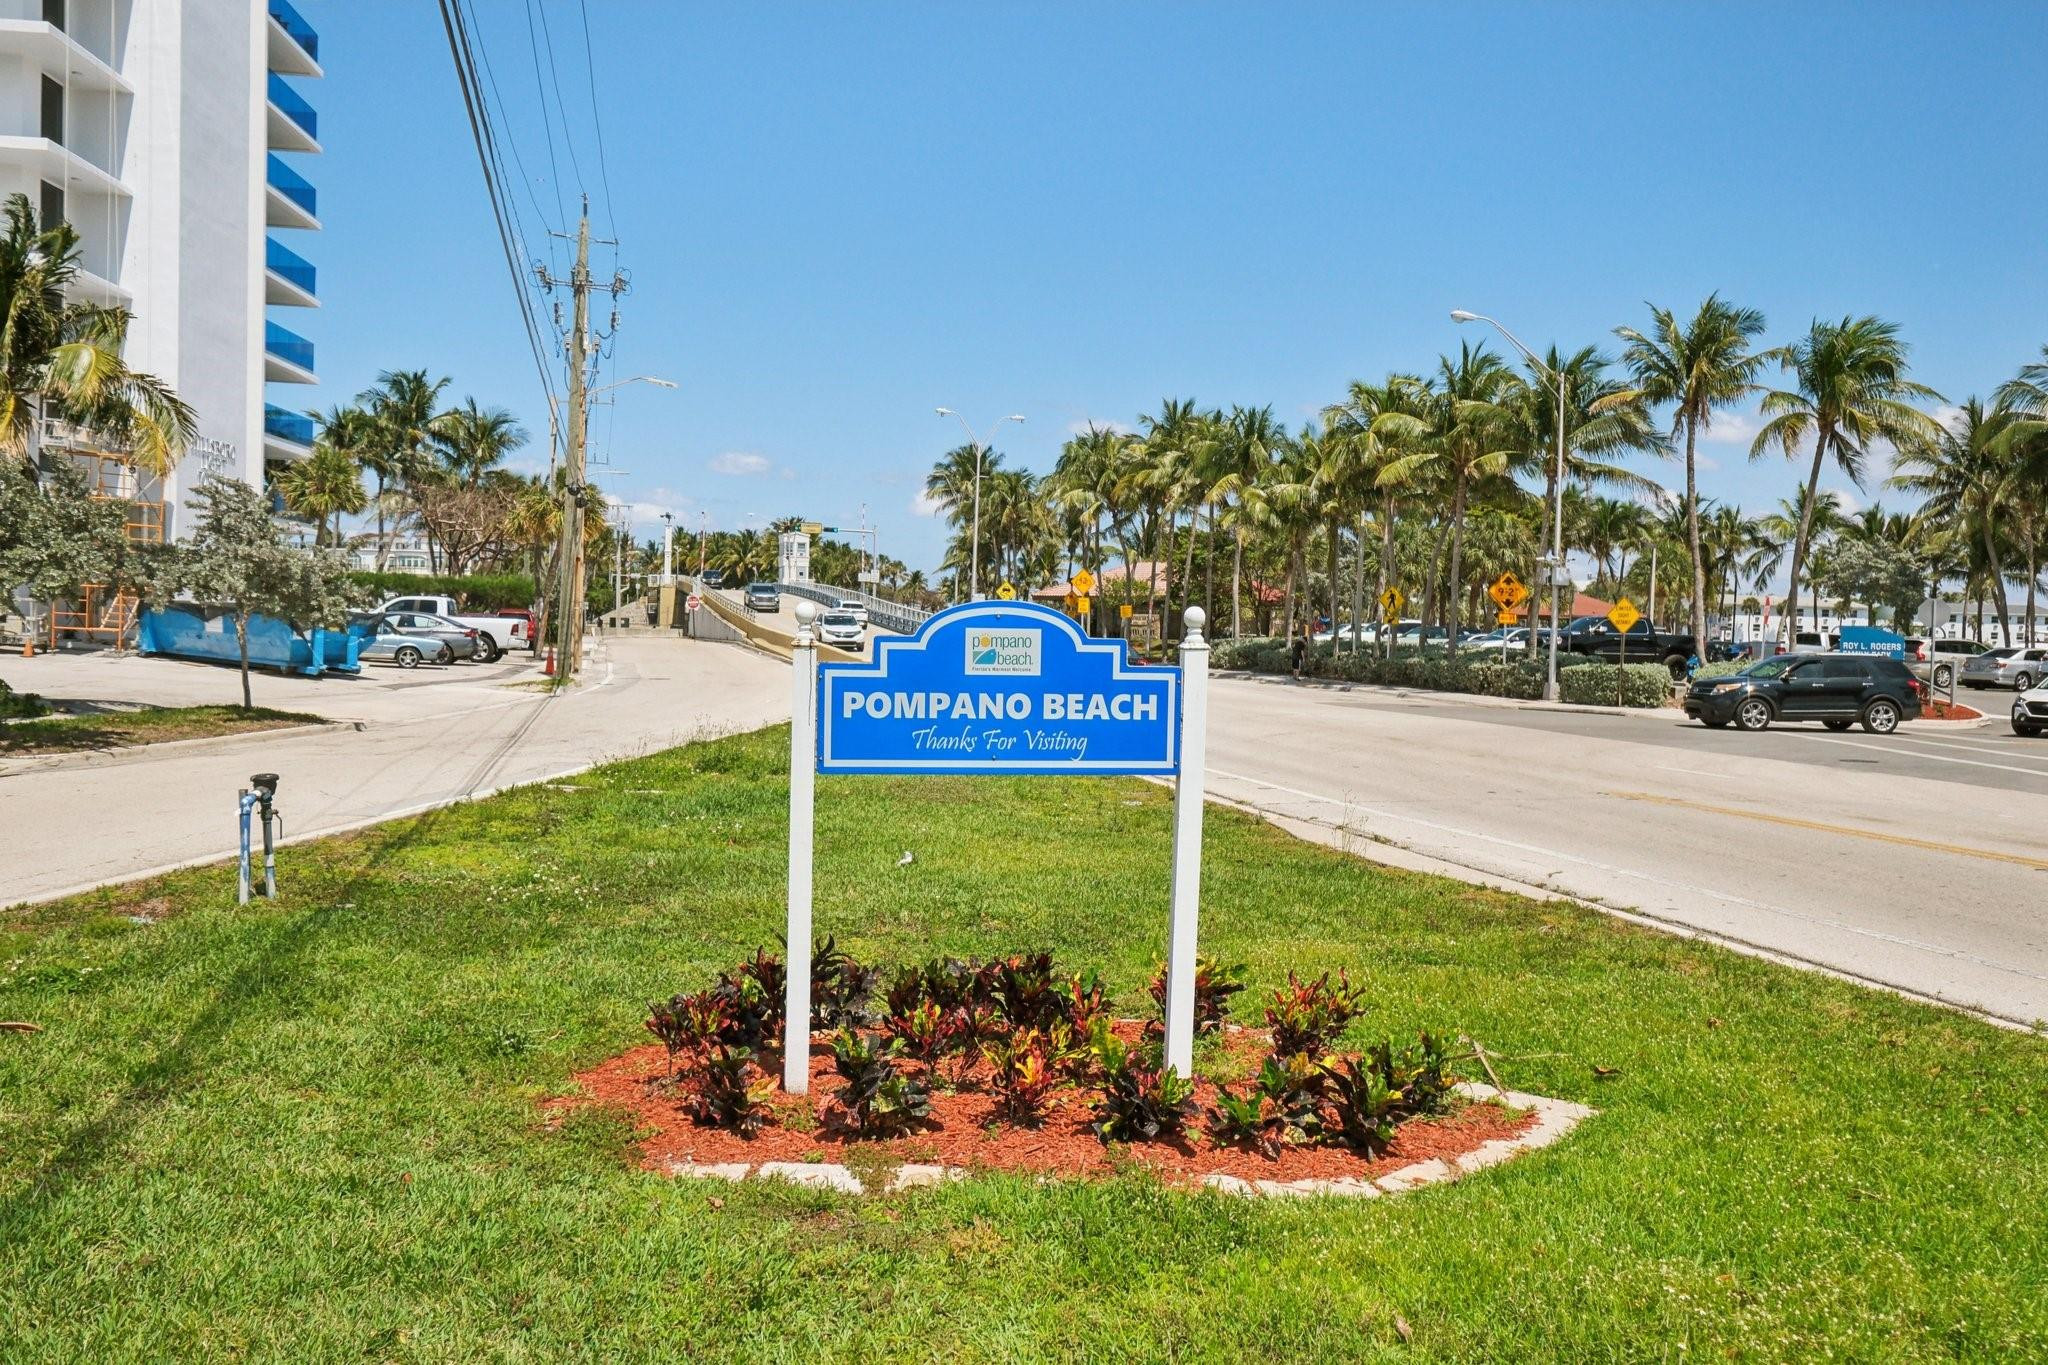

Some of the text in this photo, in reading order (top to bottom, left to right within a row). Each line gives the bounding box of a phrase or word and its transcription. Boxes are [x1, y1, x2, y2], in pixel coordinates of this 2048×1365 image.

[972, 635, 1032, 650] pompano
[1871, 642, 1902, 651] ROGERS
[843, 691, 1158, 721] POMPANO BEACH
[912, 726, 1088, 761] Thanks For Visiting
